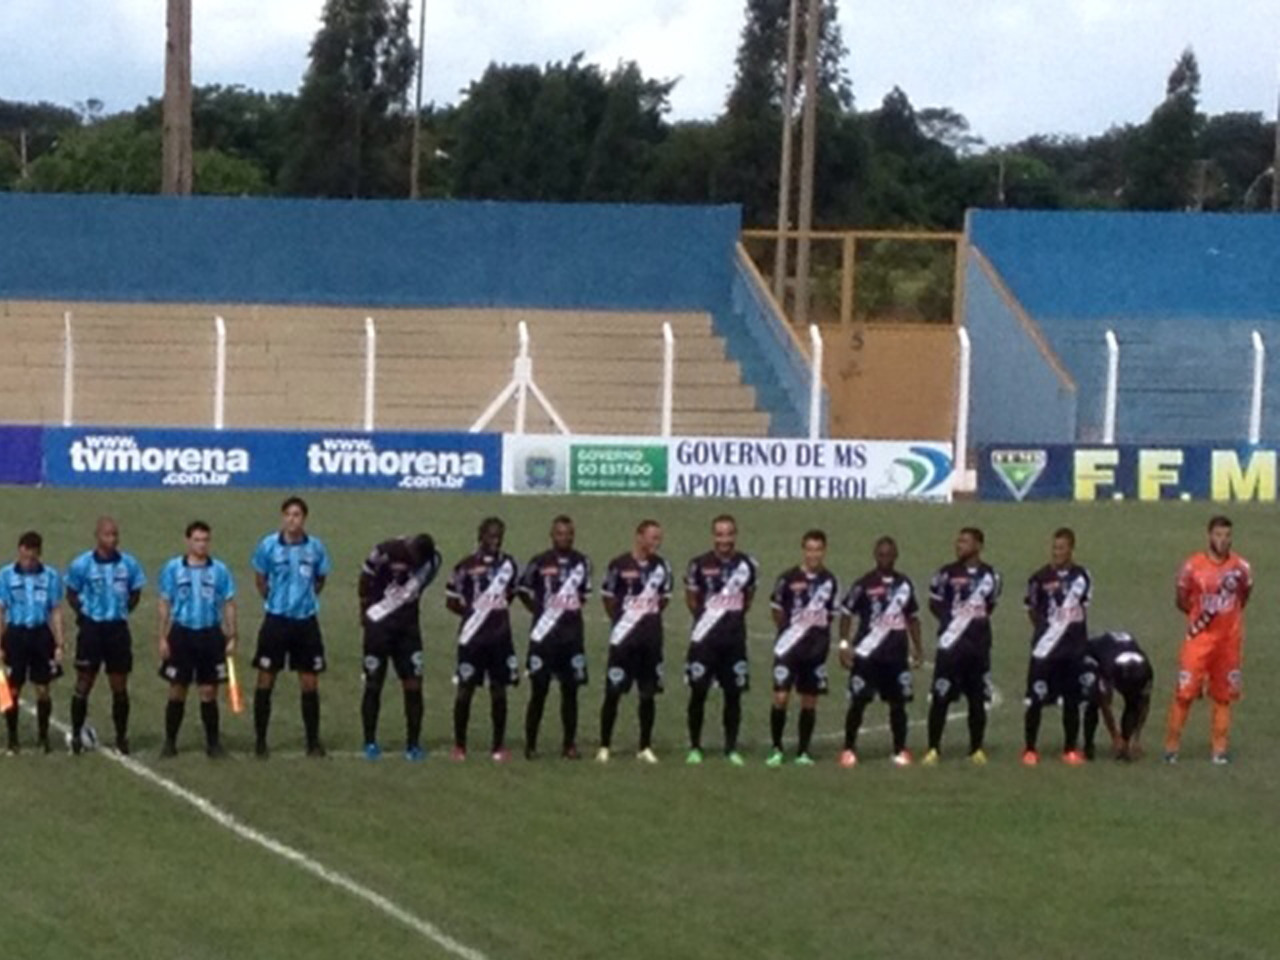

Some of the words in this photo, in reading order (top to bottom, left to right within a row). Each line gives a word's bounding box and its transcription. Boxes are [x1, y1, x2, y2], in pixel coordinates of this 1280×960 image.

[70, 441, 250, 473] tvmorena
[307, 443, 485, 476] tvmorena
[676, 440, 787, 467] GOVERNO
[795, 443, 826, 467] DE
[835, 444, 868, 468] MS
[675, 474, 741, 497] APOIA
[749, 475, 766, 497] O
